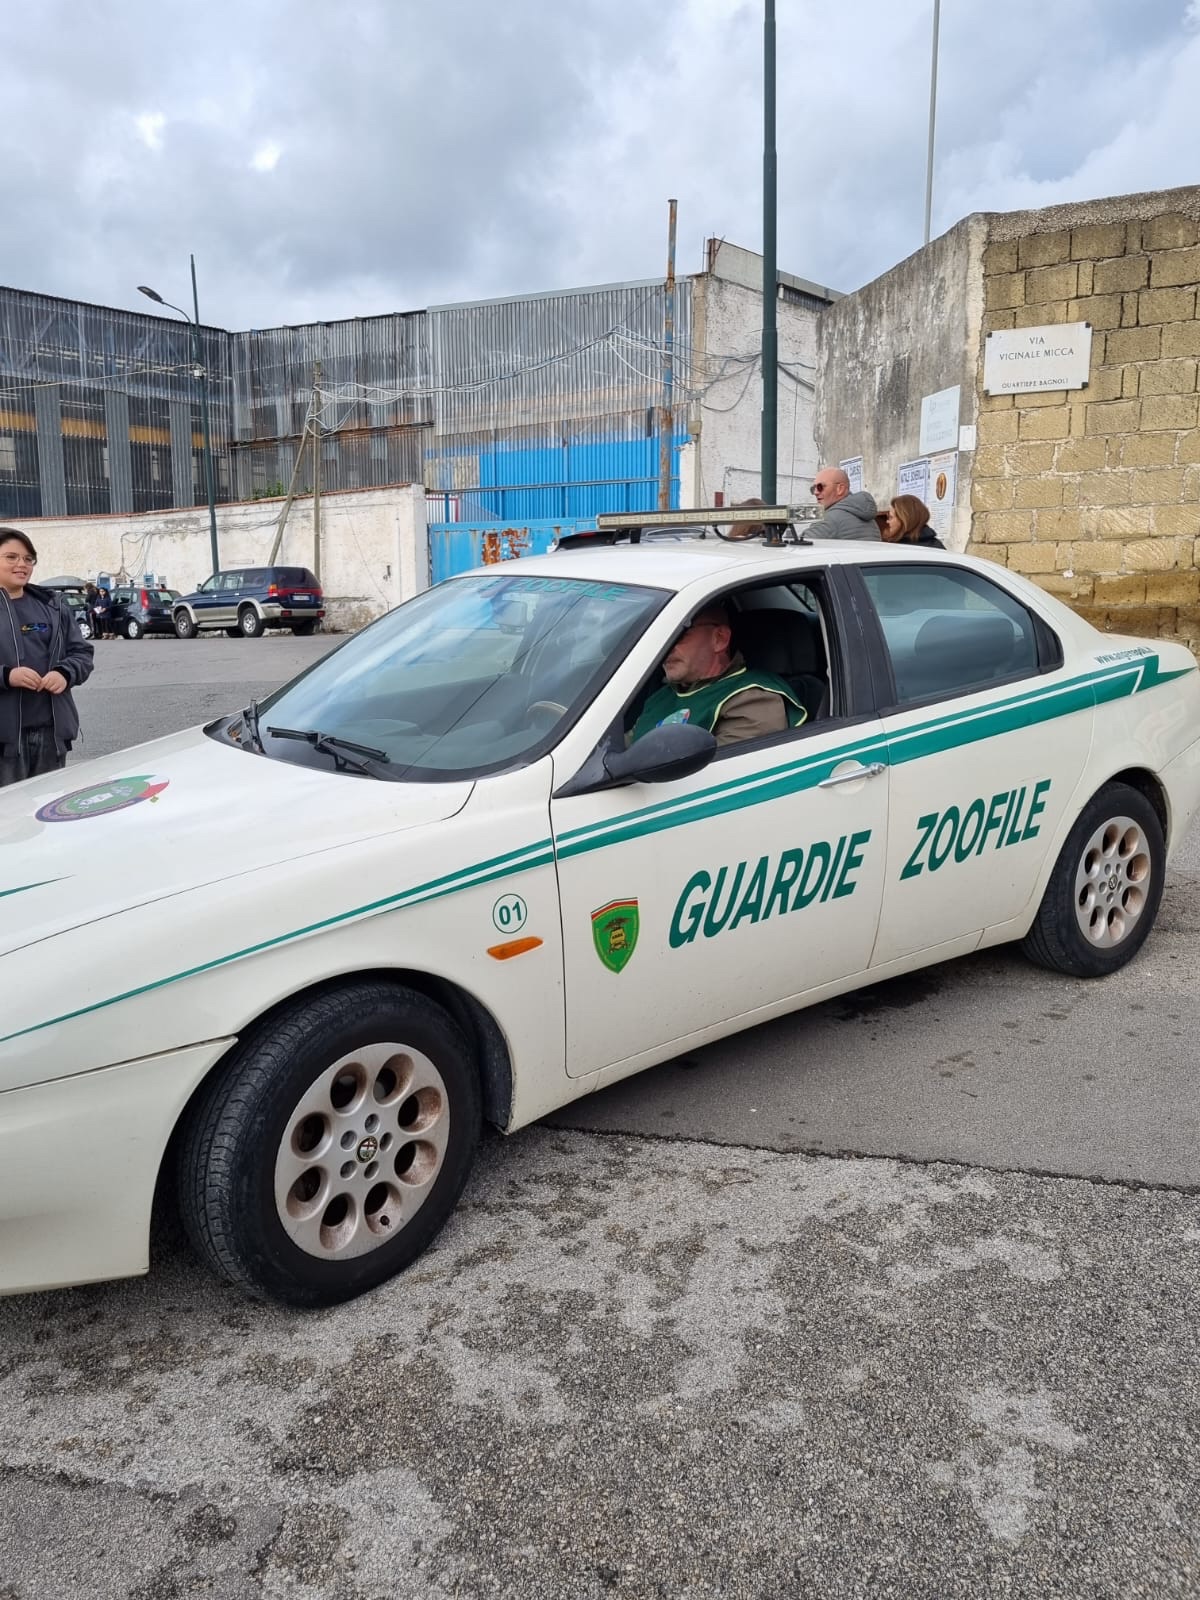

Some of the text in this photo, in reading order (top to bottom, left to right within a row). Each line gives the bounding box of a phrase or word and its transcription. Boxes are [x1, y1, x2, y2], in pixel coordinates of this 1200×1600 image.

[1029, 336, 1046, 345] VIA
[1000, 347, 1074, 361] VICINALE MICCA
[1039, 377, 1069, 387] BAGNOLI
[508, 579, 628, 602] ZOOFILE
[668, 778, 1052, 949] GUARDIE ZOOFILE
[498, 901, 522, 926] 01
